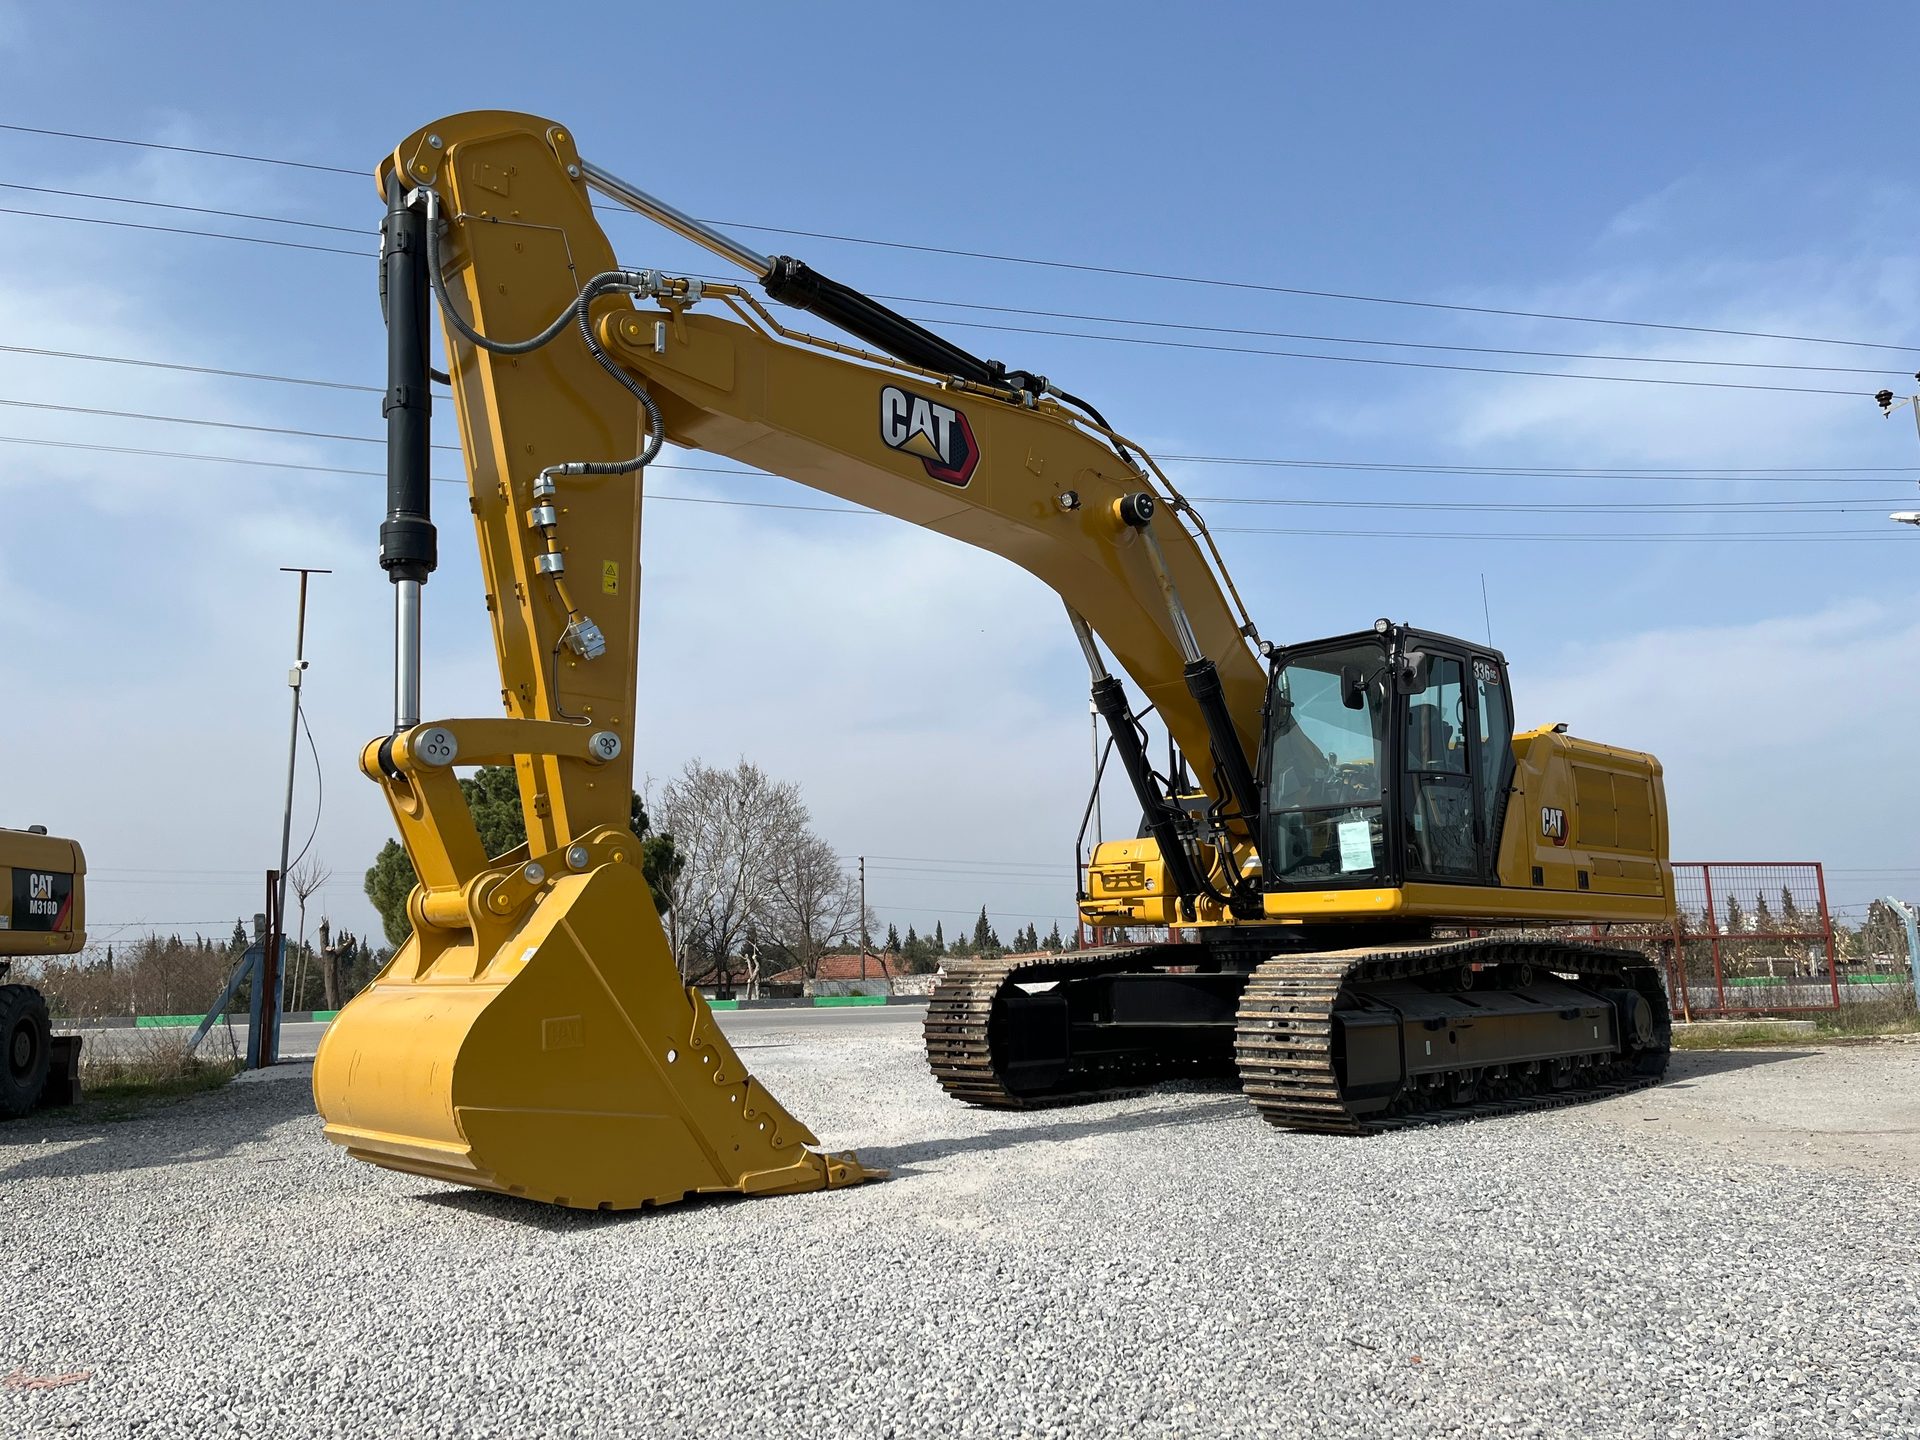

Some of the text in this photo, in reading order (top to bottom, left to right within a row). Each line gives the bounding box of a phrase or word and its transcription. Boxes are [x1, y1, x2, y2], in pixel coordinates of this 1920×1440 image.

[882, 387, 956, 464] CAT
[1473, 661, 1491, 681] 336
[1542, 807, 1563, 837] CAT
[29, 873, 53, 899] CAT
[29, 900, 58, 915] M318D
